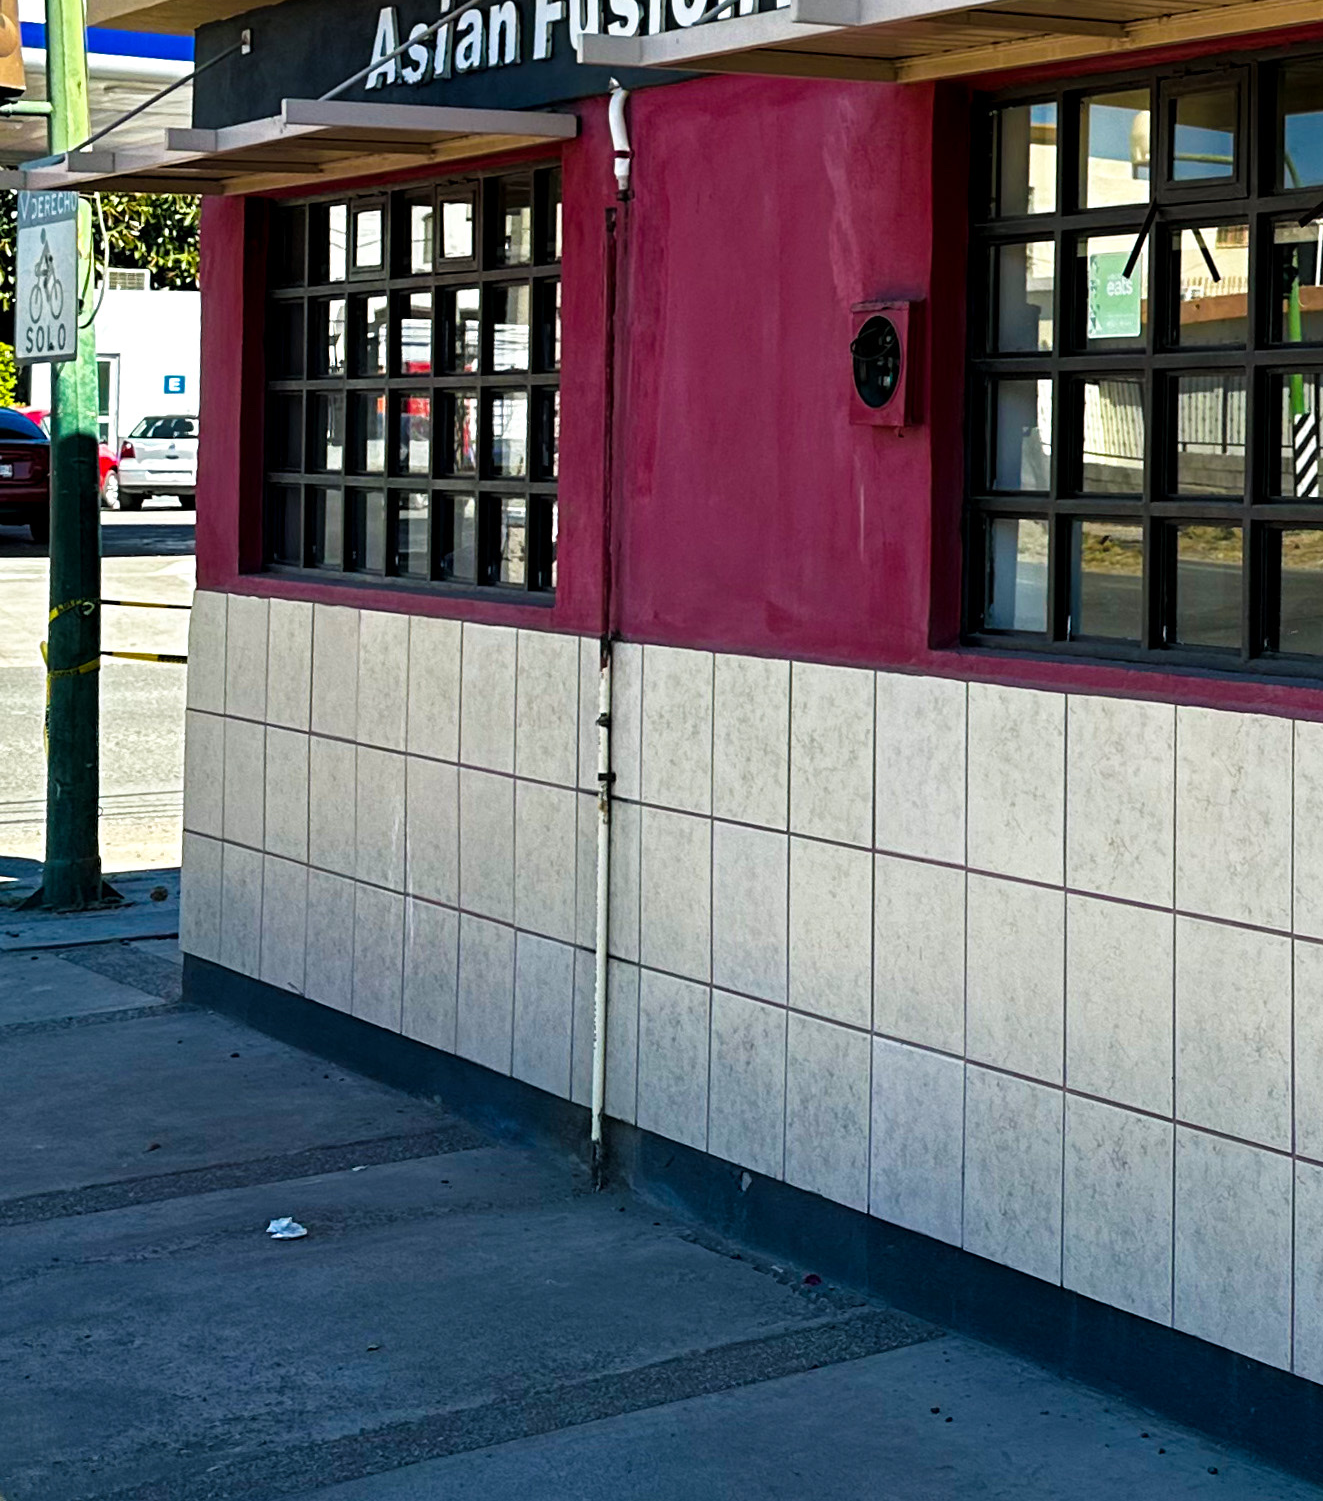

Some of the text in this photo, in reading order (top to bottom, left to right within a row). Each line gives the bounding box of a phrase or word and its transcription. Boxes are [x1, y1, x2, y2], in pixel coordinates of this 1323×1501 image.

[31, 190, 78, 220] DERECHO
[1106, 274, 1133, 296] eats
[25, 323, 67, 353] SOLO
[169, 377, 180, 391] E
